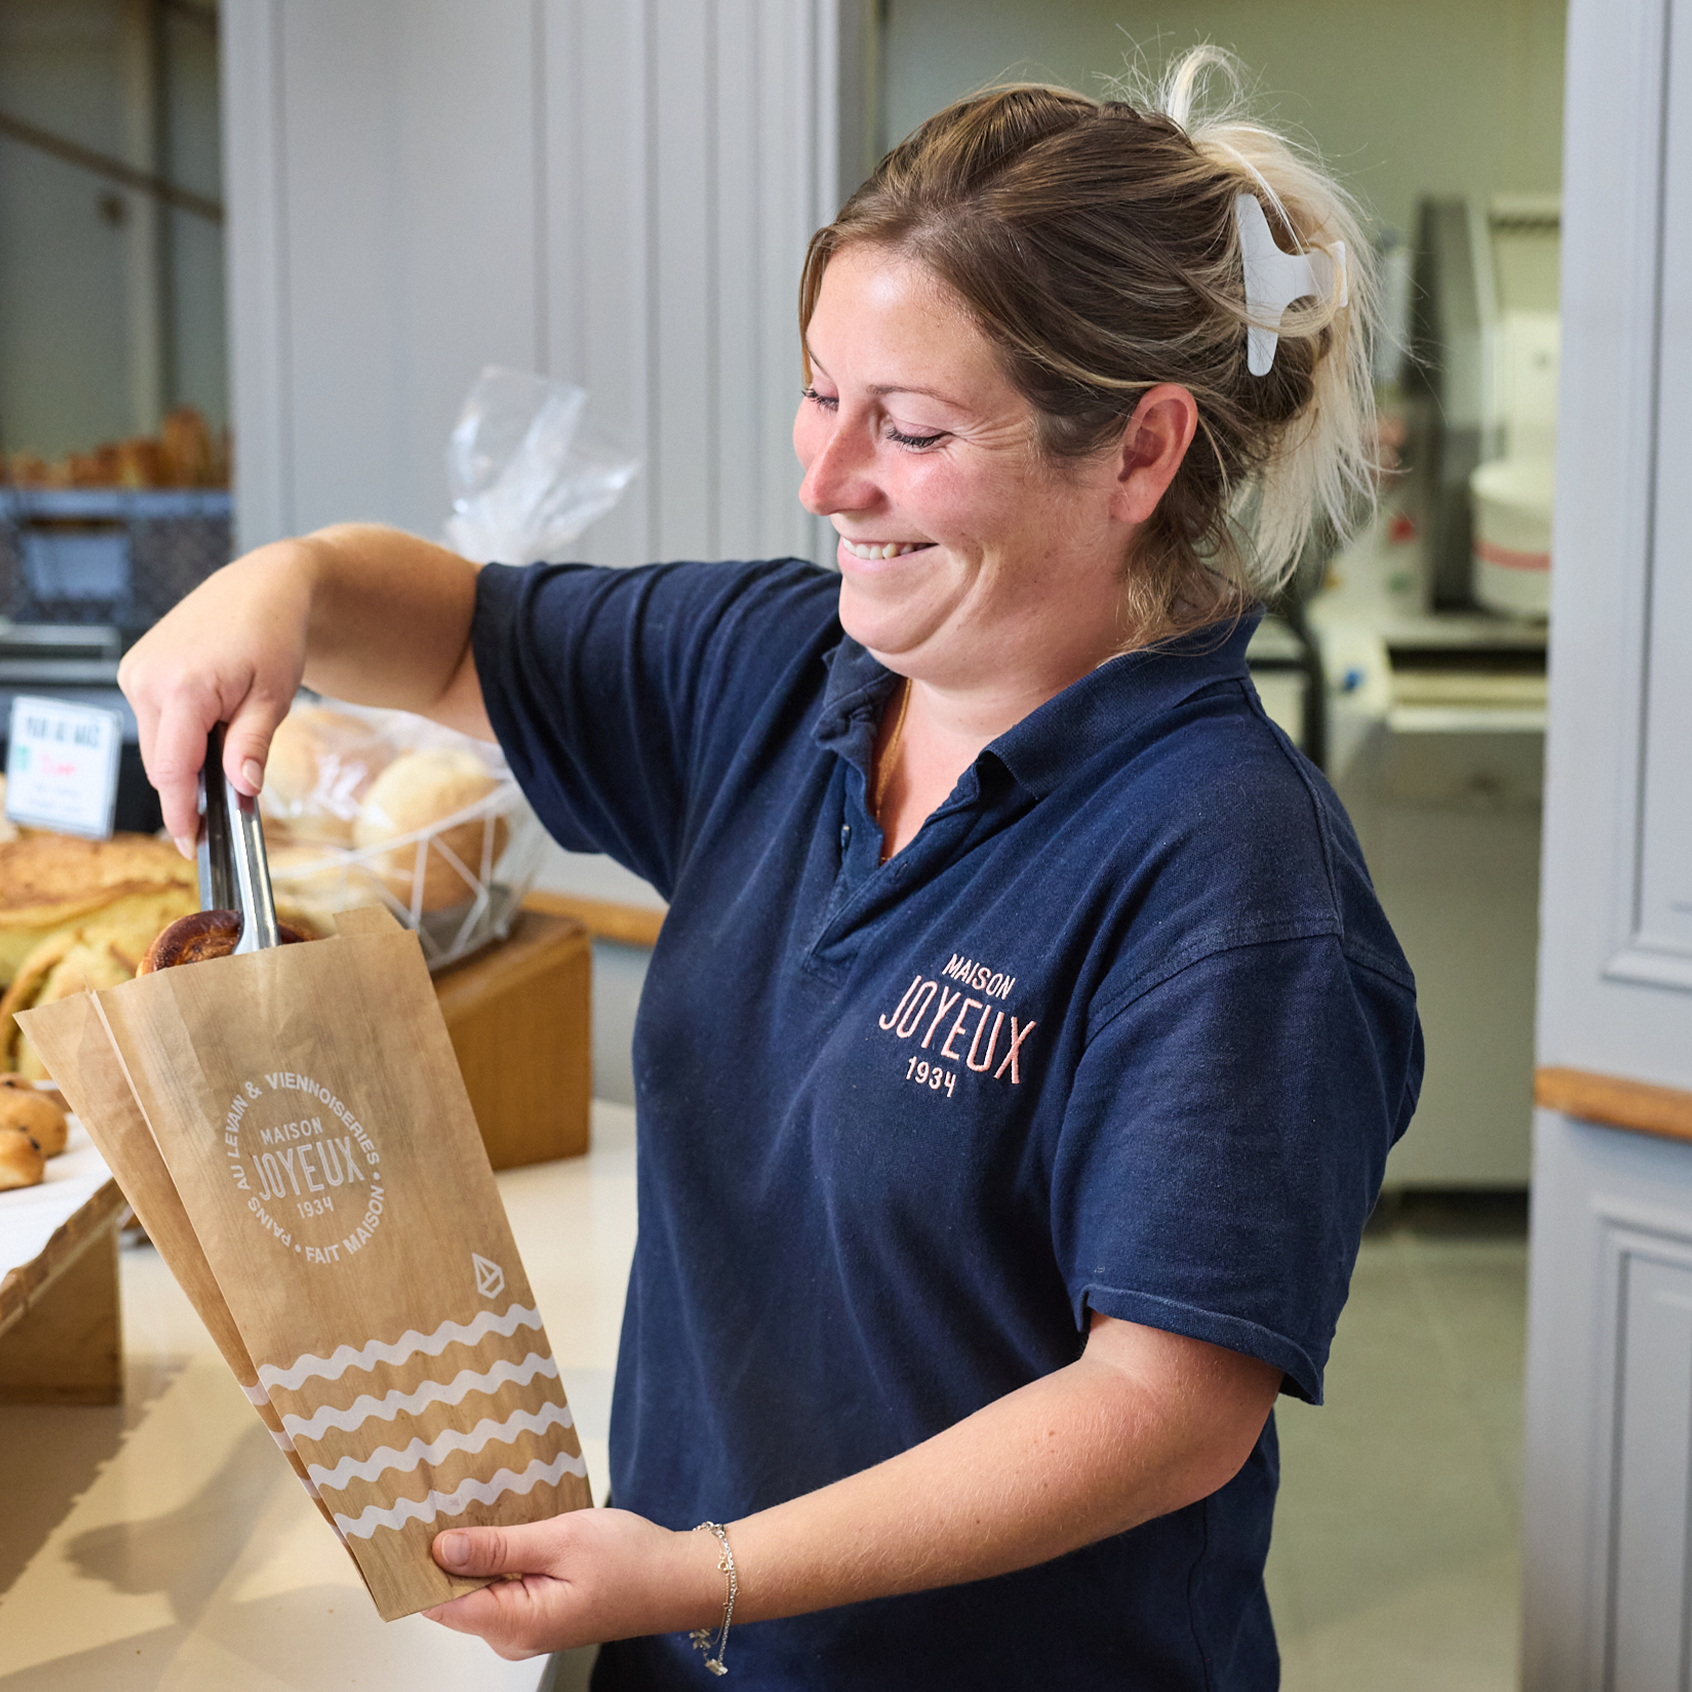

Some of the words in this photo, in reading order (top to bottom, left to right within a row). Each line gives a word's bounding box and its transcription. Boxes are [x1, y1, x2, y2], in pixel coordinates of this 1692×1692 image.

[942, 953, 1016, 1000] MAISON
[878, 975, 1037, 1085] JOYEUX
[244, 1081, 263, 1099] &
[906, 1056, 956, 1097] 1934
[225, 1094, 249, 1159] LEVAIN
[259, 1117, 324, 1146] MAISON
[265, 1072, 380, 1165] VIENNOISERIES
[230, 1165, 251, 1190] AU
[252, 1136, 365, 1201] JOYEUX
[248, 1196, 291, 1247] PAINS
[297, 1196, 335, 1219] 1934
[305, 1244, 340, 1264] FAIT
[342, 1185, 384, 1254] MAISON
